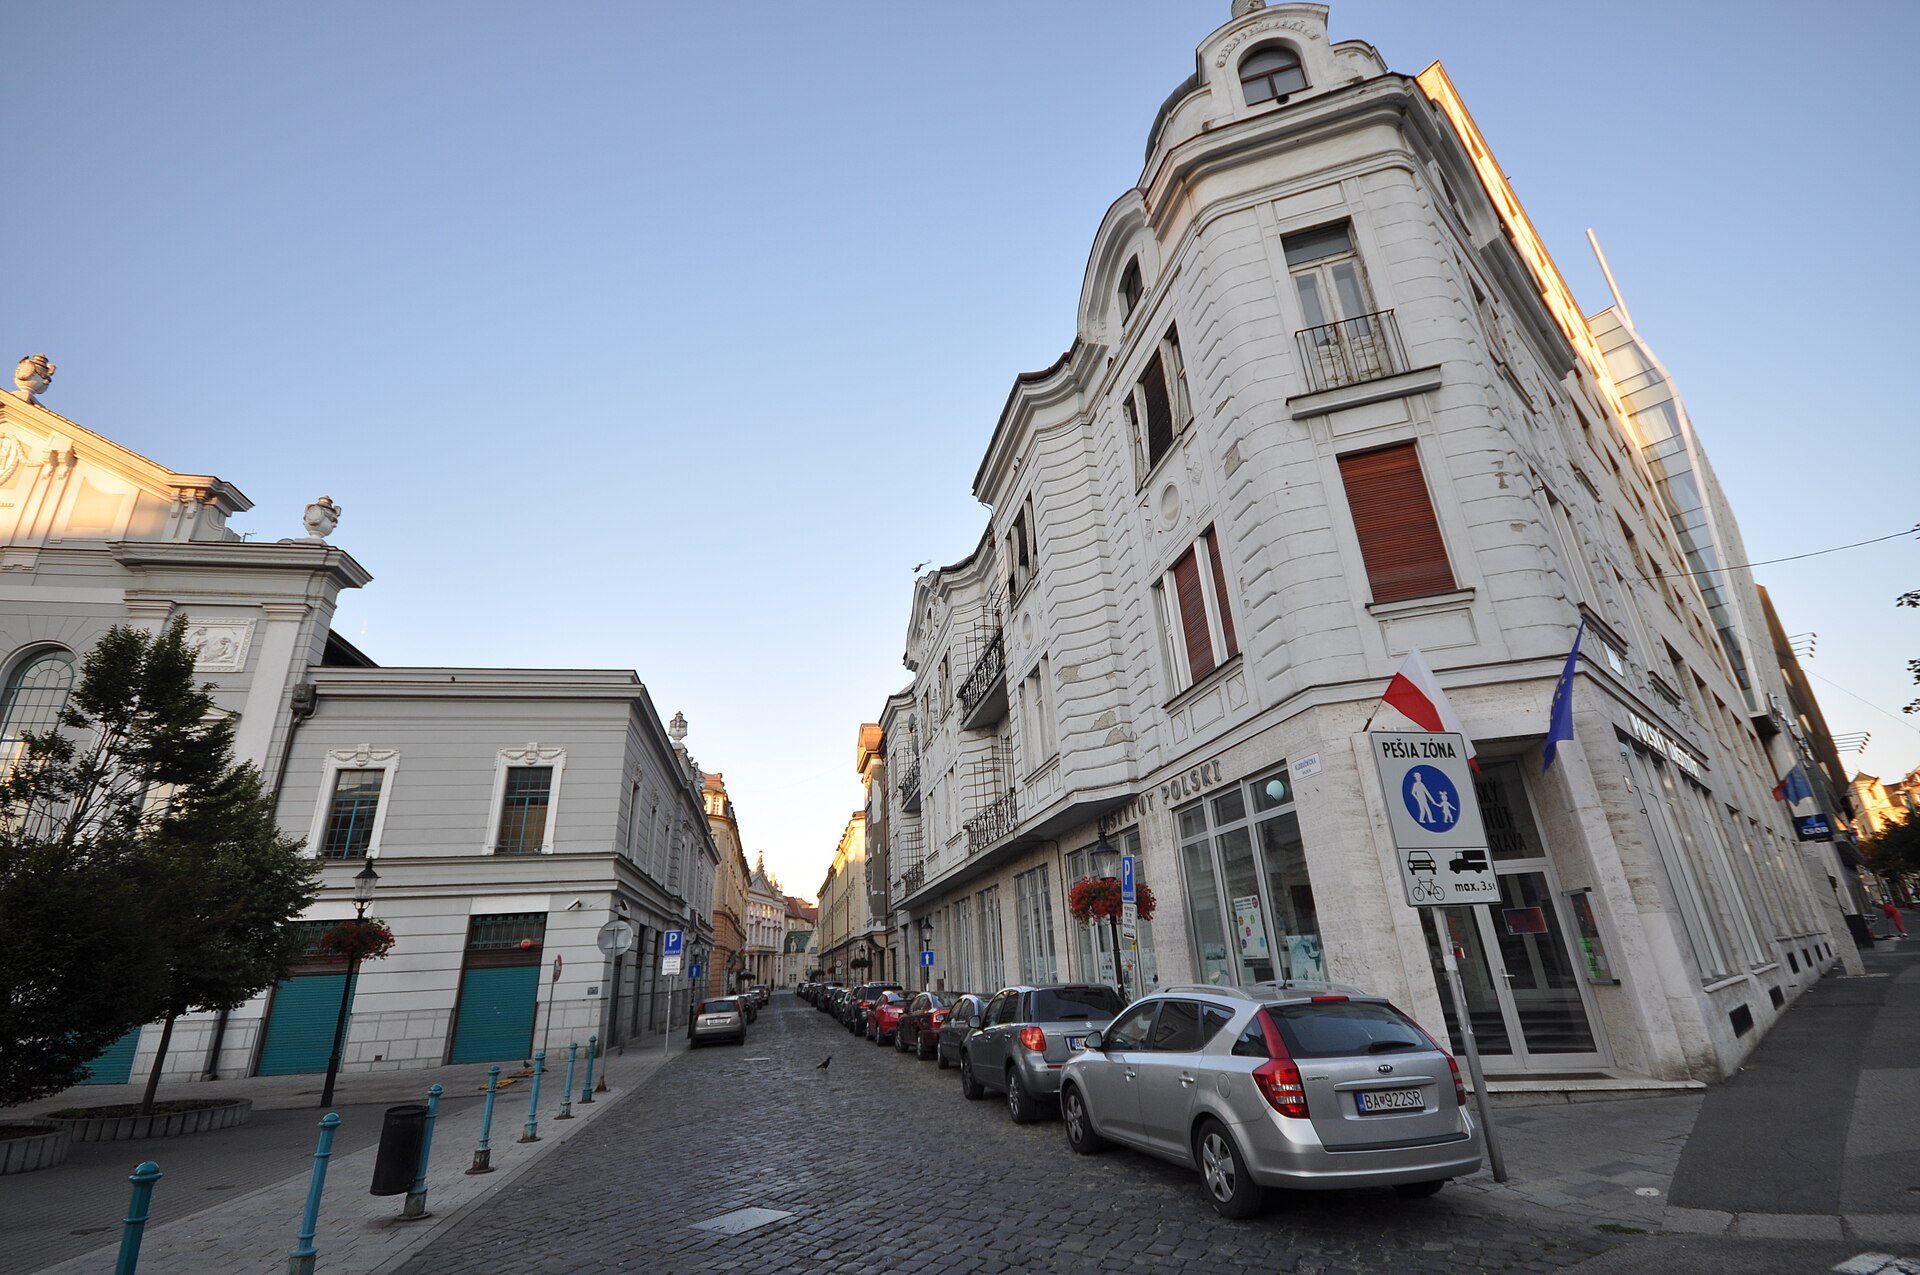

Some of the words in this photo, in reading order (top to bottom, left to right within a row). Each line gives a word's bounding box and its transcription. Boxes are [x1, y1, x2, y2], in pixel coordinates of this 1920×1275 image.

[1382, 738, 1420, 758] PEŠIA
[1420, 738, 1457, 758] ZÓNA
[1100, 792, 1154, 832] NSTYTUT
[1160, 759, 1223, 805] POLSKI
[1489, 832, 1527, 852] SLAVA
[1124, 860, 1131, 886] P
[1455, 883, 1480, 892] max.
[668, 933, 678, 947] P
